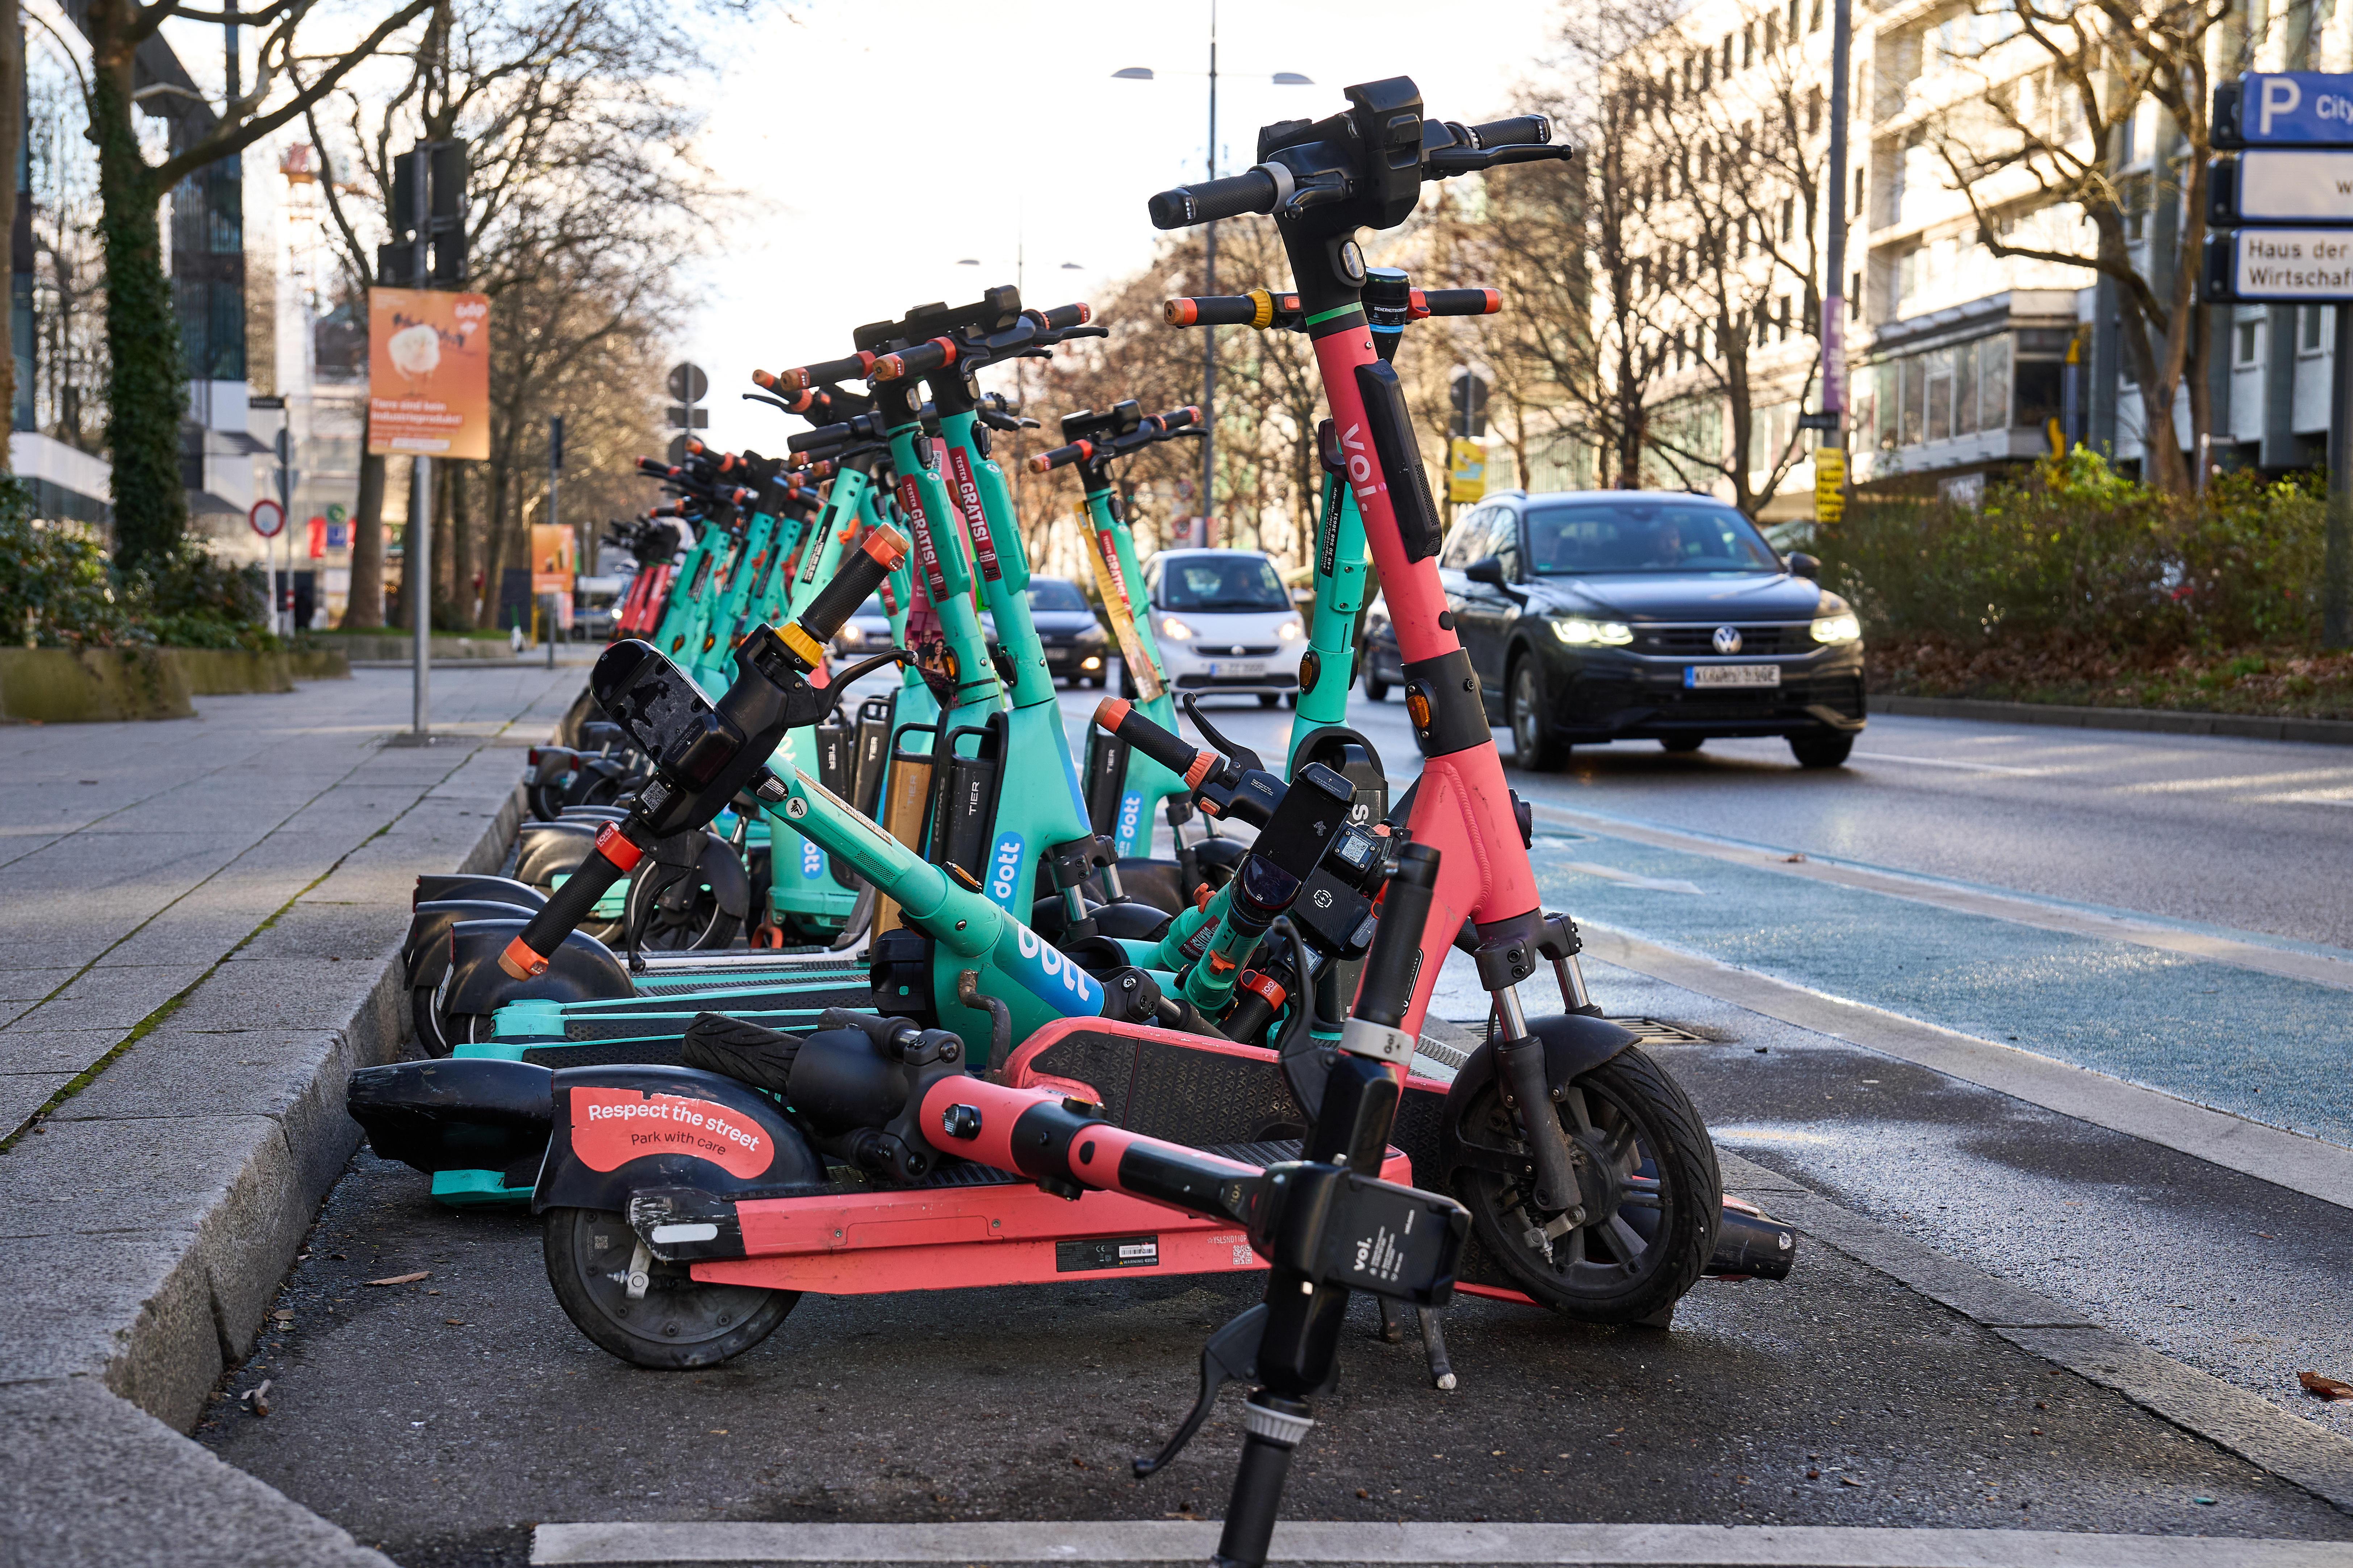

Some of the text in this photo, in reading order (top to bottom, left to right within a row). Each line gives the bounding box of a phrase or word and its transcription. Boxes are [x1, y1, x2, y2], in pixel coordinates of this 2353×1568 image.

[2260, 77, 2353, 136] P City
[2249, 238, 2348, 259] Haus der
[955, 455, 989, 542] TESTEN GRATIS!
[906, 482, 937, 565] TESTEN GRATIS!
[1323, 487, 1337, 569] stuttgart@de.tier-ops.app
[1329, 548, 1333, 556] 30
[828, 743, 836, 770] TIER
[1106, 749, 1115, 774] TIER
[907, 775, 917, 806] TIER
[969, 781, 979, 816] TIER
[1120, 797, 1140, 839] dott
[596, 828, 611, 845] GO!
[804, 836, 820, 873] ott
[993, 842, 1020, 898] dott
[1261, 981, 1275, 995] GO!
[588, 1103, 760, 1152] Respect the street
[631, 1131, 726, 1155] Park with care
